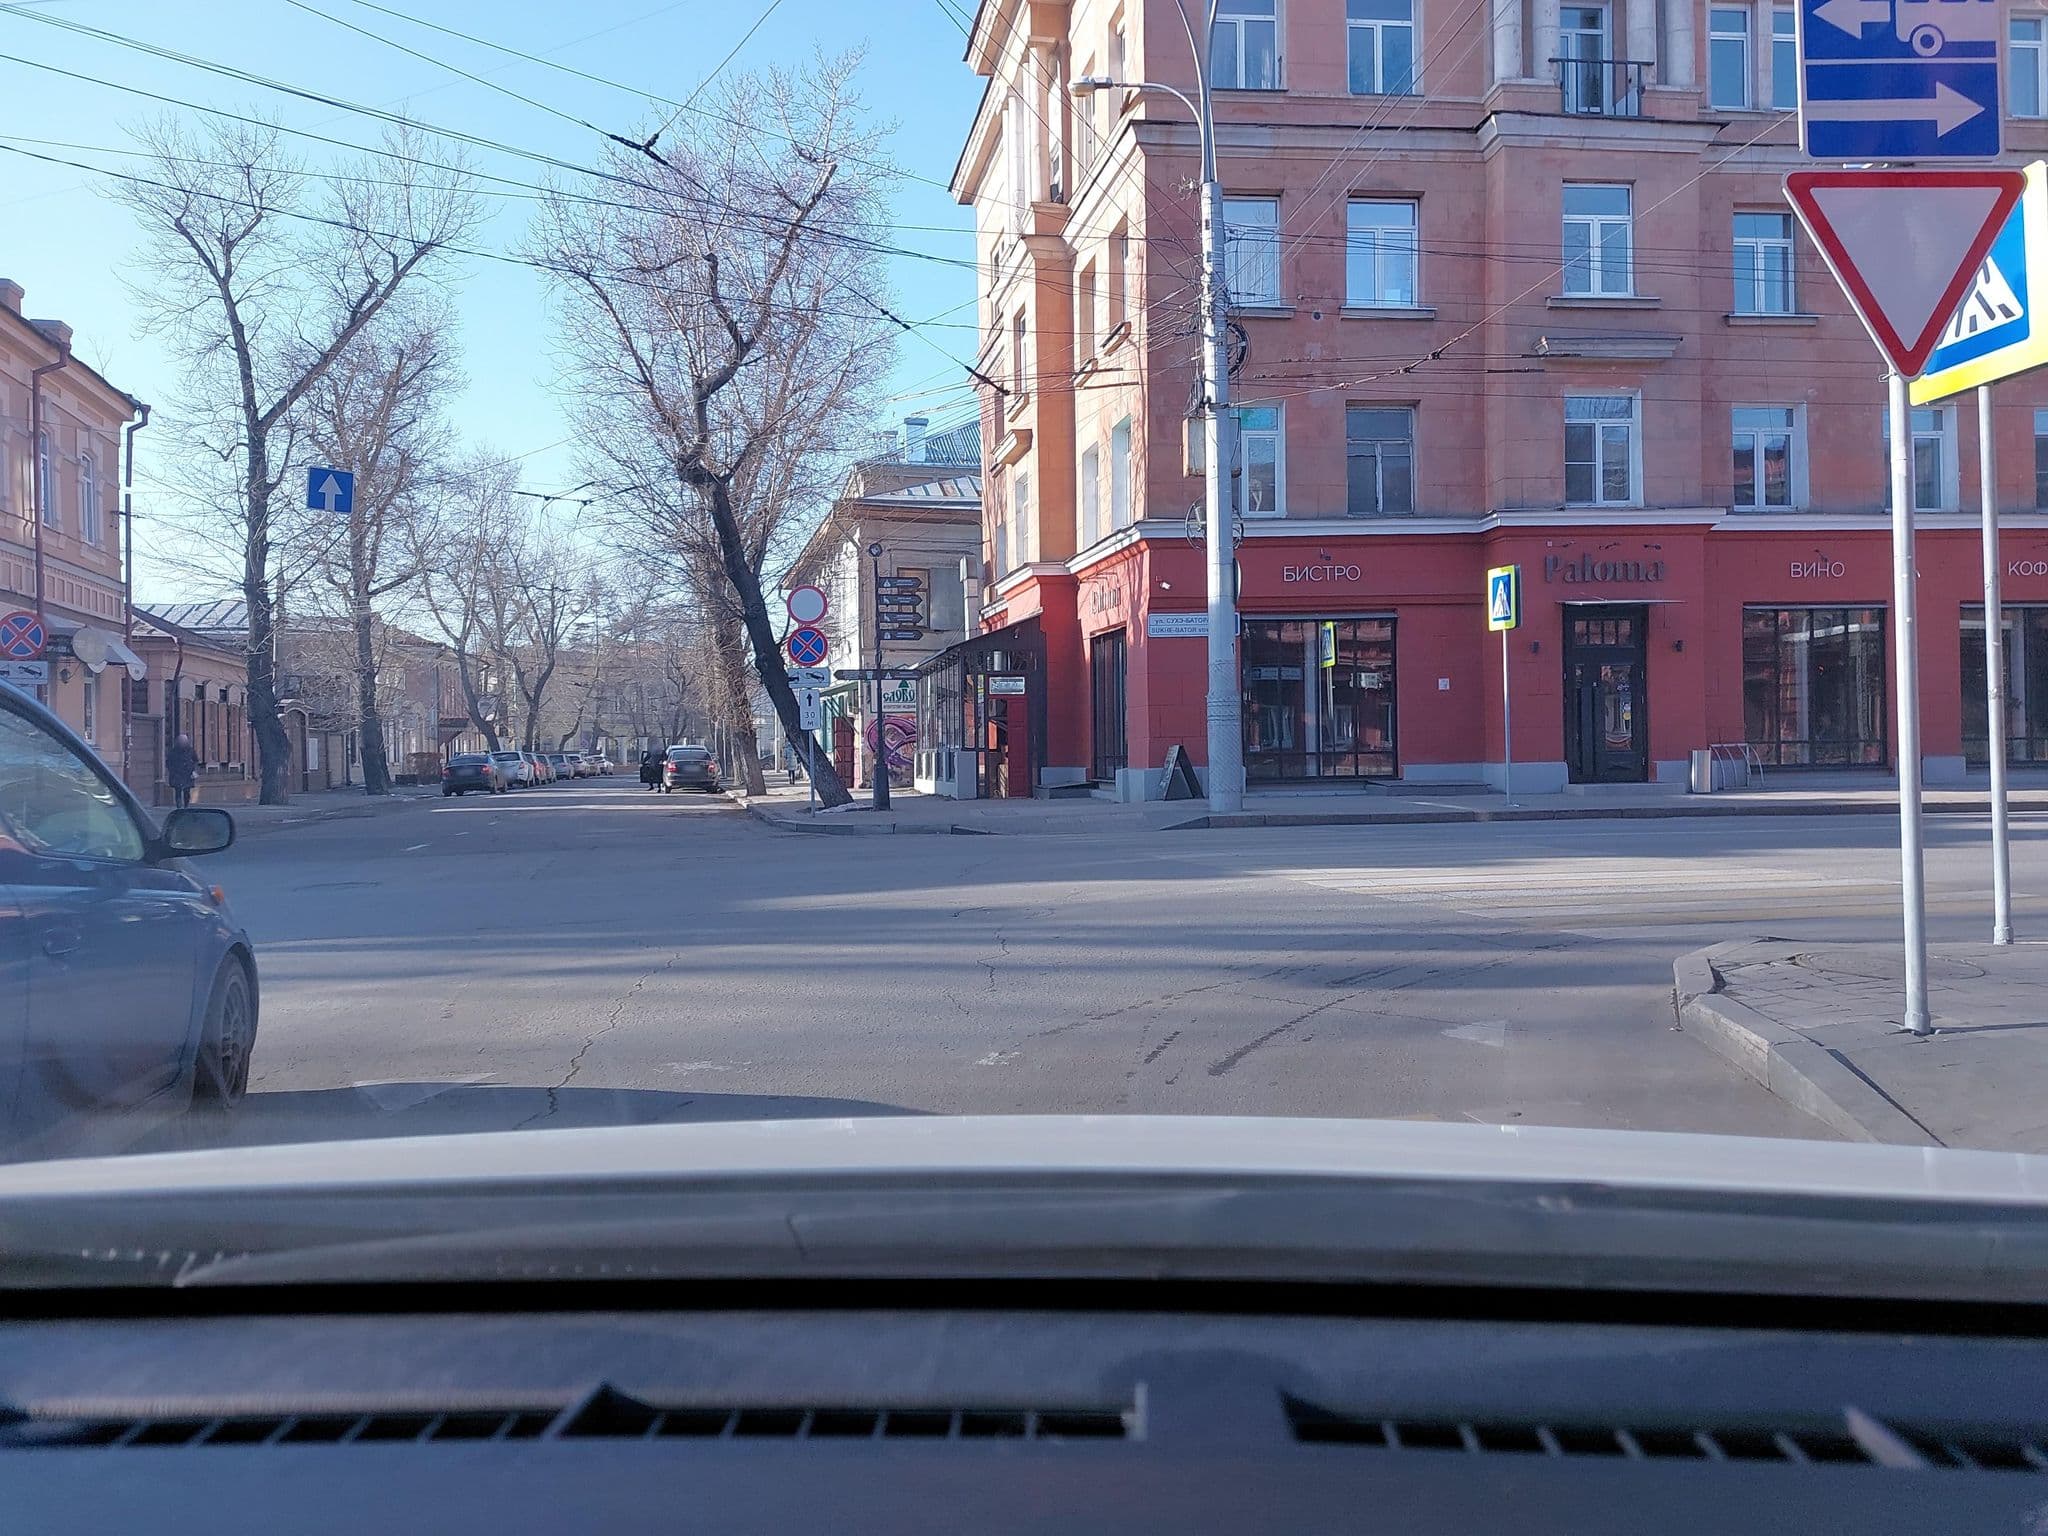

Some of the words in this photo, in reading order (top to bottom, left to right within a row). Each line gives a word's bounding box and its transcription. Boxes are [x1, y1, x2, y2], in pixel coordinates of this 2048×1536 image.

[1283, 565, 1361, 582] БИСТРО
[1544, 552, 1666, 583] Paloma
[1790, 561, 1845, 578] ВИНО
[2008, 560, 2048, 576] КОФ
[805, 711, 816, 719] 30
